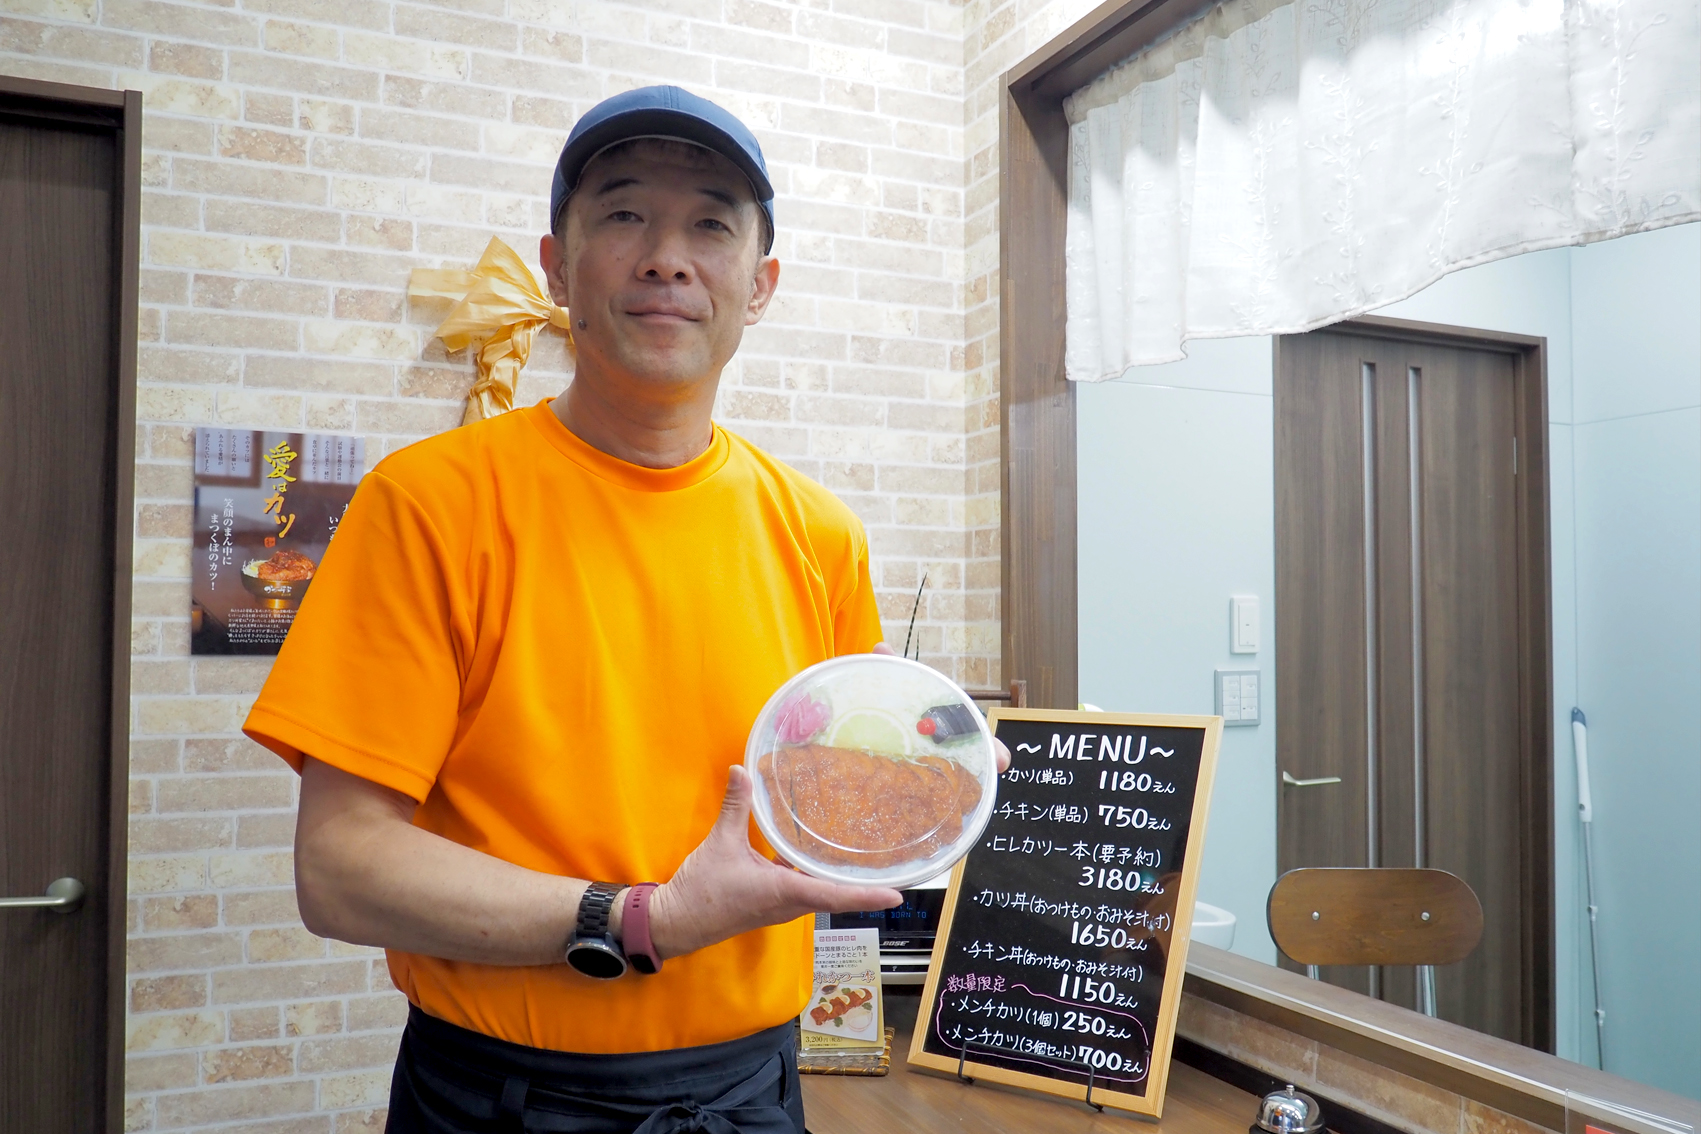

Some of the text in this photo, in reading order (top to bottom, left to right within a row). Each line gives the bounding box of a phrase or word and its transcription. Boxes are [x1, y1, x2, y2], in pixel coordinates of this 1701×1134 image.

[263, 440, 298, 539] 愛はカツ
[222, 498, 234, 566] 笑顔のまん中に
[208, 513, 220, 591] まつくぼのカツ!
[1099, 770, 1176, 794] 1180えん
[1098, 804, 1172, 831] 750えん
[1078, 866, 1165, 895] 3180えん
[869, 911, 886, 919] WAS
[891, 911, 911, 919] BORN
[917, 911, 927, 919] TO
[1071, 921, 1148, 951] 1650えん
[946, 973, 1007, 993] 数量限定
[1059, 973, 1139, 1009] 1150えん
[1061, 1011, 1131, 1040] 250えん
[1078, 1045, 1143, 1073] 700えん
